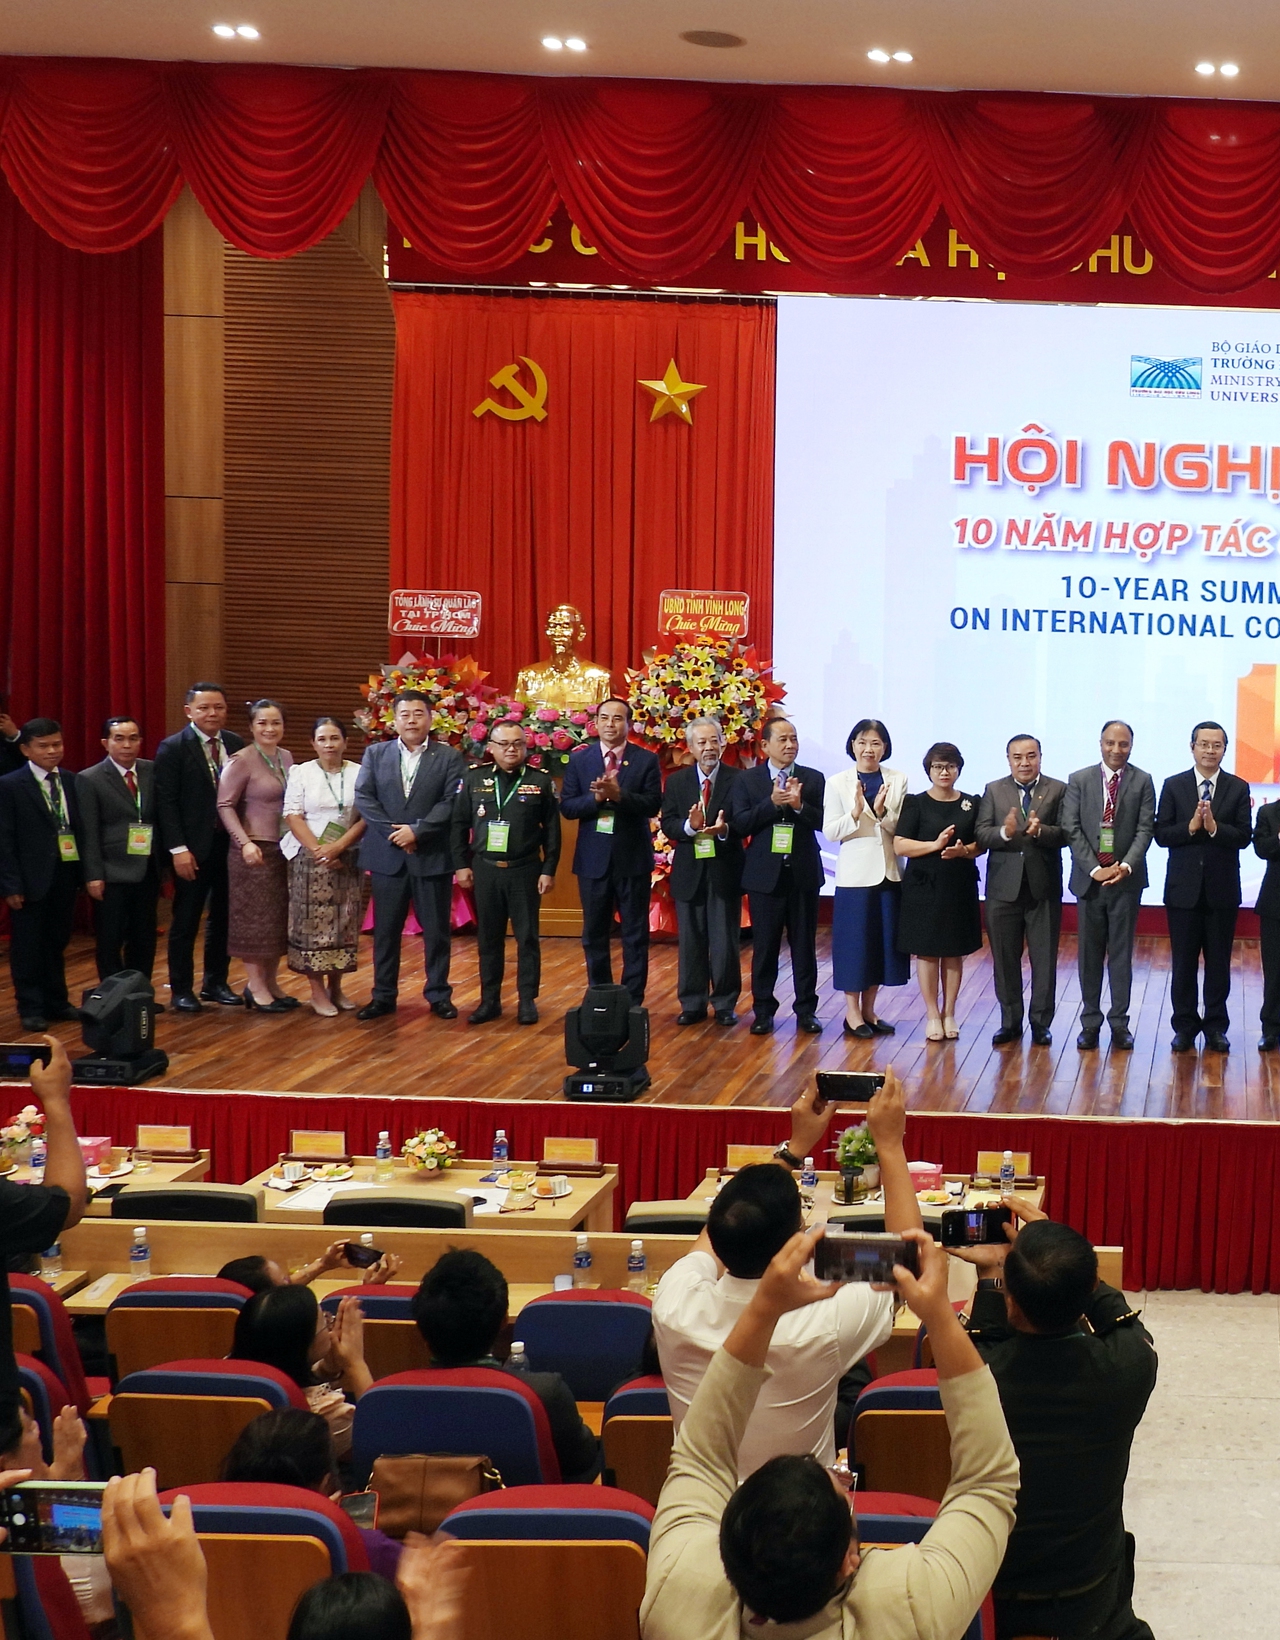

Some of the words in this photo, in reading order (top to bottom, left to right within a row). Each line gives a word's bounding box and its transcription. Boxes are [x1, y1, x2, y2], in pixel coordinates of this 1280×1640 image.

[1211, 340, 1231, 355] BỘ
[1234, 339, 1271, 354] GIÁO
[1211, 355, 1275, 370] TRƯỜNG
[953, 422, 1080, 493] HỘI
[953, 517, 994, 546] 10
[1004, 511, 1093, 548] NĂM
[1103, 520, 1190, 558] HỢP
[1200, 518, 1272, 554] TÁC
[1061, 576, 1189, 602] 10-YEAR
[663, 598, 685, 614] UBND
[725, 600, 745, 616] LONG
[665, 614, 698, 631] Chúc
[699, 615, 741, 635] Mừng
[950, 606, 990, 631] ON
[1001, 608, 1234, 638] INTERNATIONAL
